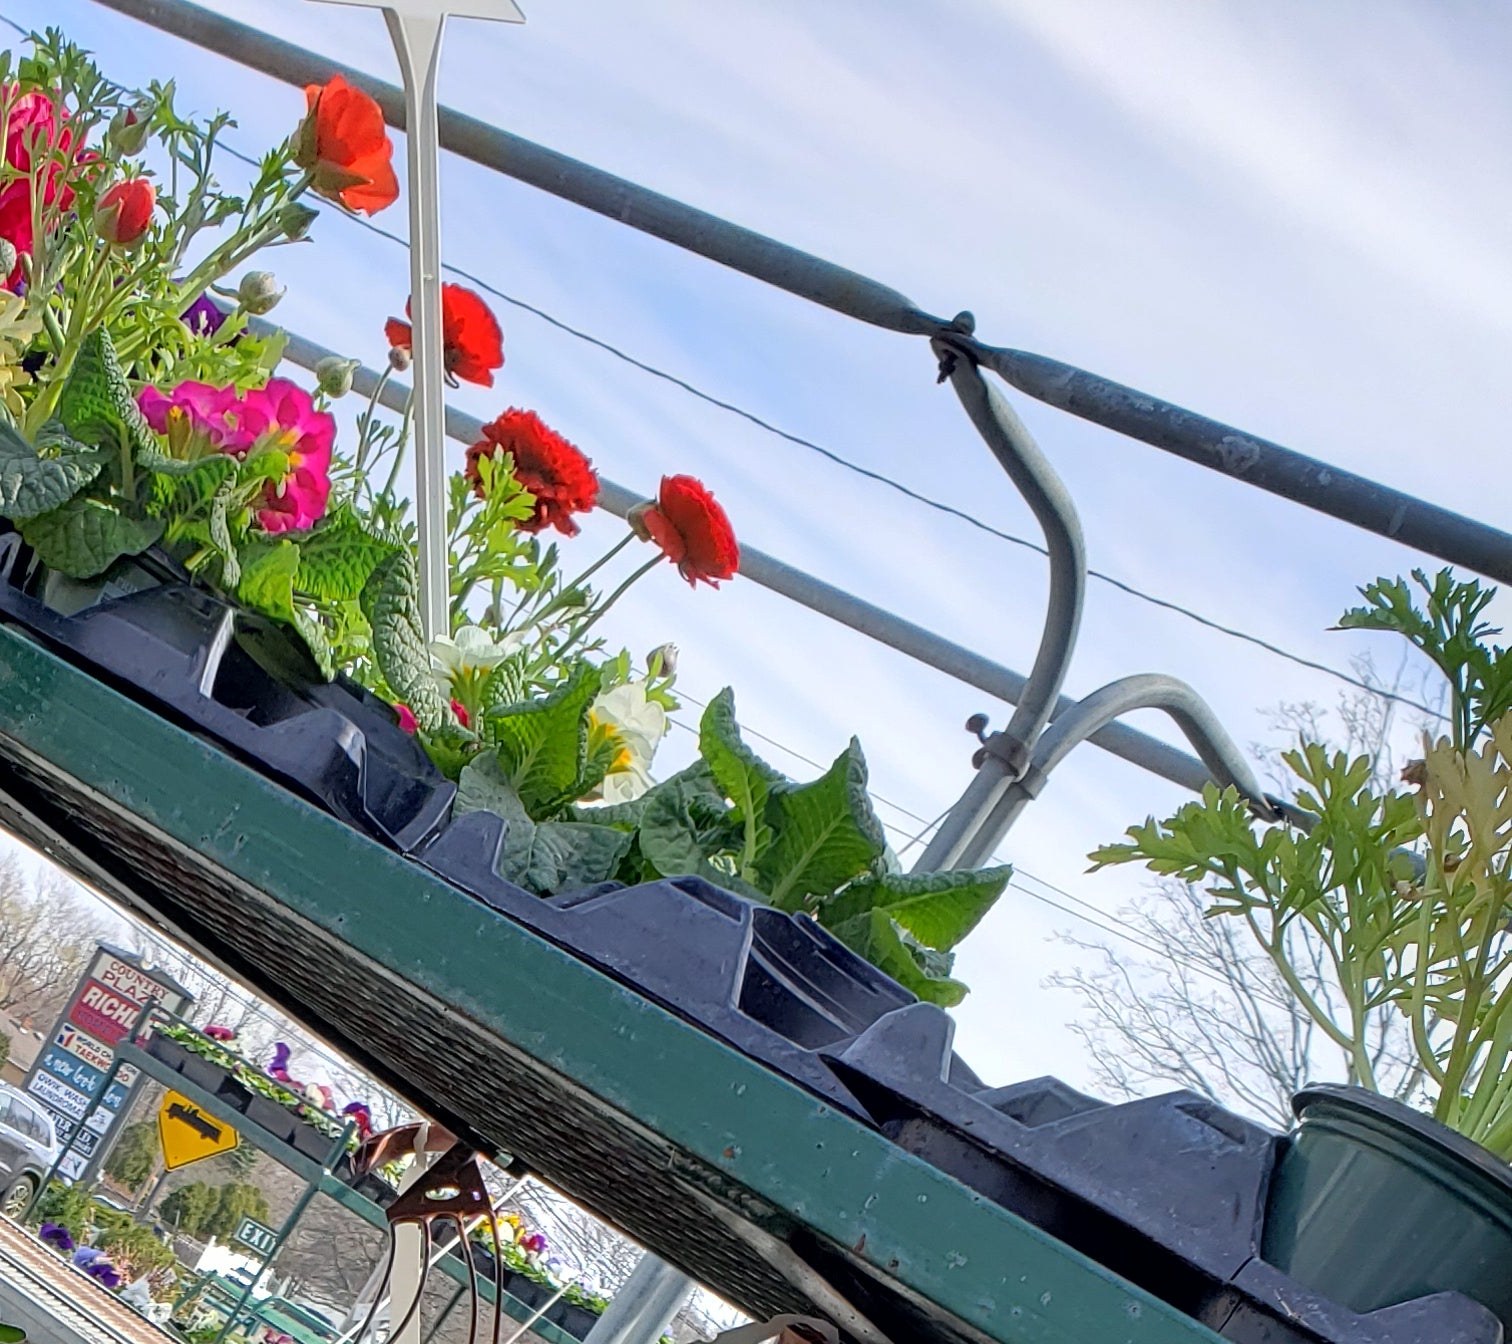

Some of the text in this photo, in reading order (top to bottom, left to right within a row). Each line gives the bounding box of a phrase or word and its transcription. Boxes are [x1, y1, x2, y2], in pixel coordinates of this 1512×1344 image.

[101, 969, 162, 1013] PLAZ
[111, 961, 170, 1000] COUNTRY
[82, 985, 153, 1040] RICHLN
[74, 1044, 129, 1082] TAEKWODO
[240, 1223, 277, 1253] EXIT
